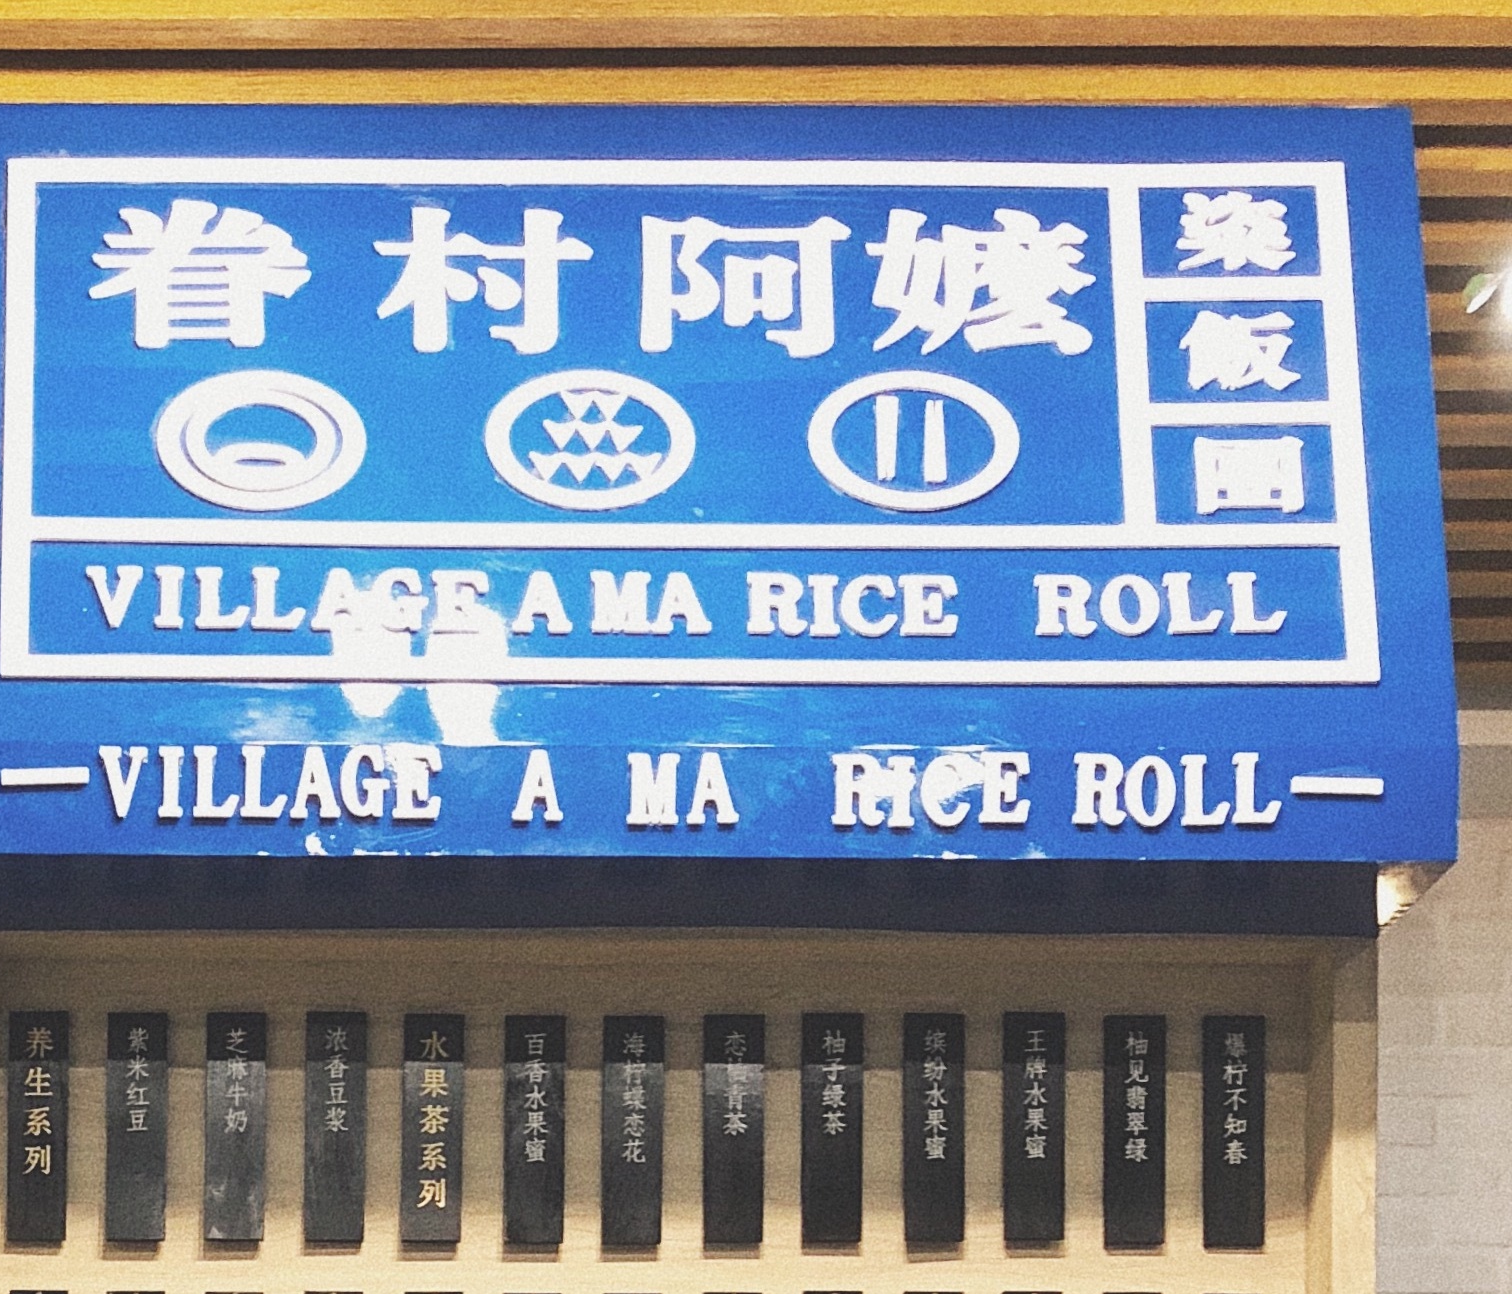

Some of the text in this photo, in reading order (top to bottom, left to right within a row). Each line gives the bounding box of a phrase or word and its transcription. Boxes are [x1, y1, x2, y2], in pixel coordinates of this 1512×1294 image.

[86, 565, 1288, 638] VILLAGE A MA RICE ROLL
[98, 743, 1283, 829] VILLAGE A MA RICE ROLL
[23, 1026, 54, 1175] 养生系列
[125, 1027, 150, 1132] 紫米红豆
[224, 1028, 249, 1134] 芝麻牛奶
[324, 1027, 349, 1133] 浓香豆浆
[416, 1030, 449, 1209] 水果茶系列
[523, 1032, 549, 1163] 百香水果蜜
[821, 1029, 847, 1135] 柚子绿茶
[922, 1029, 947, 1160] 缤纷水果蜜
[1023, 1029, 1048, 1160] 王牌水果蜜
